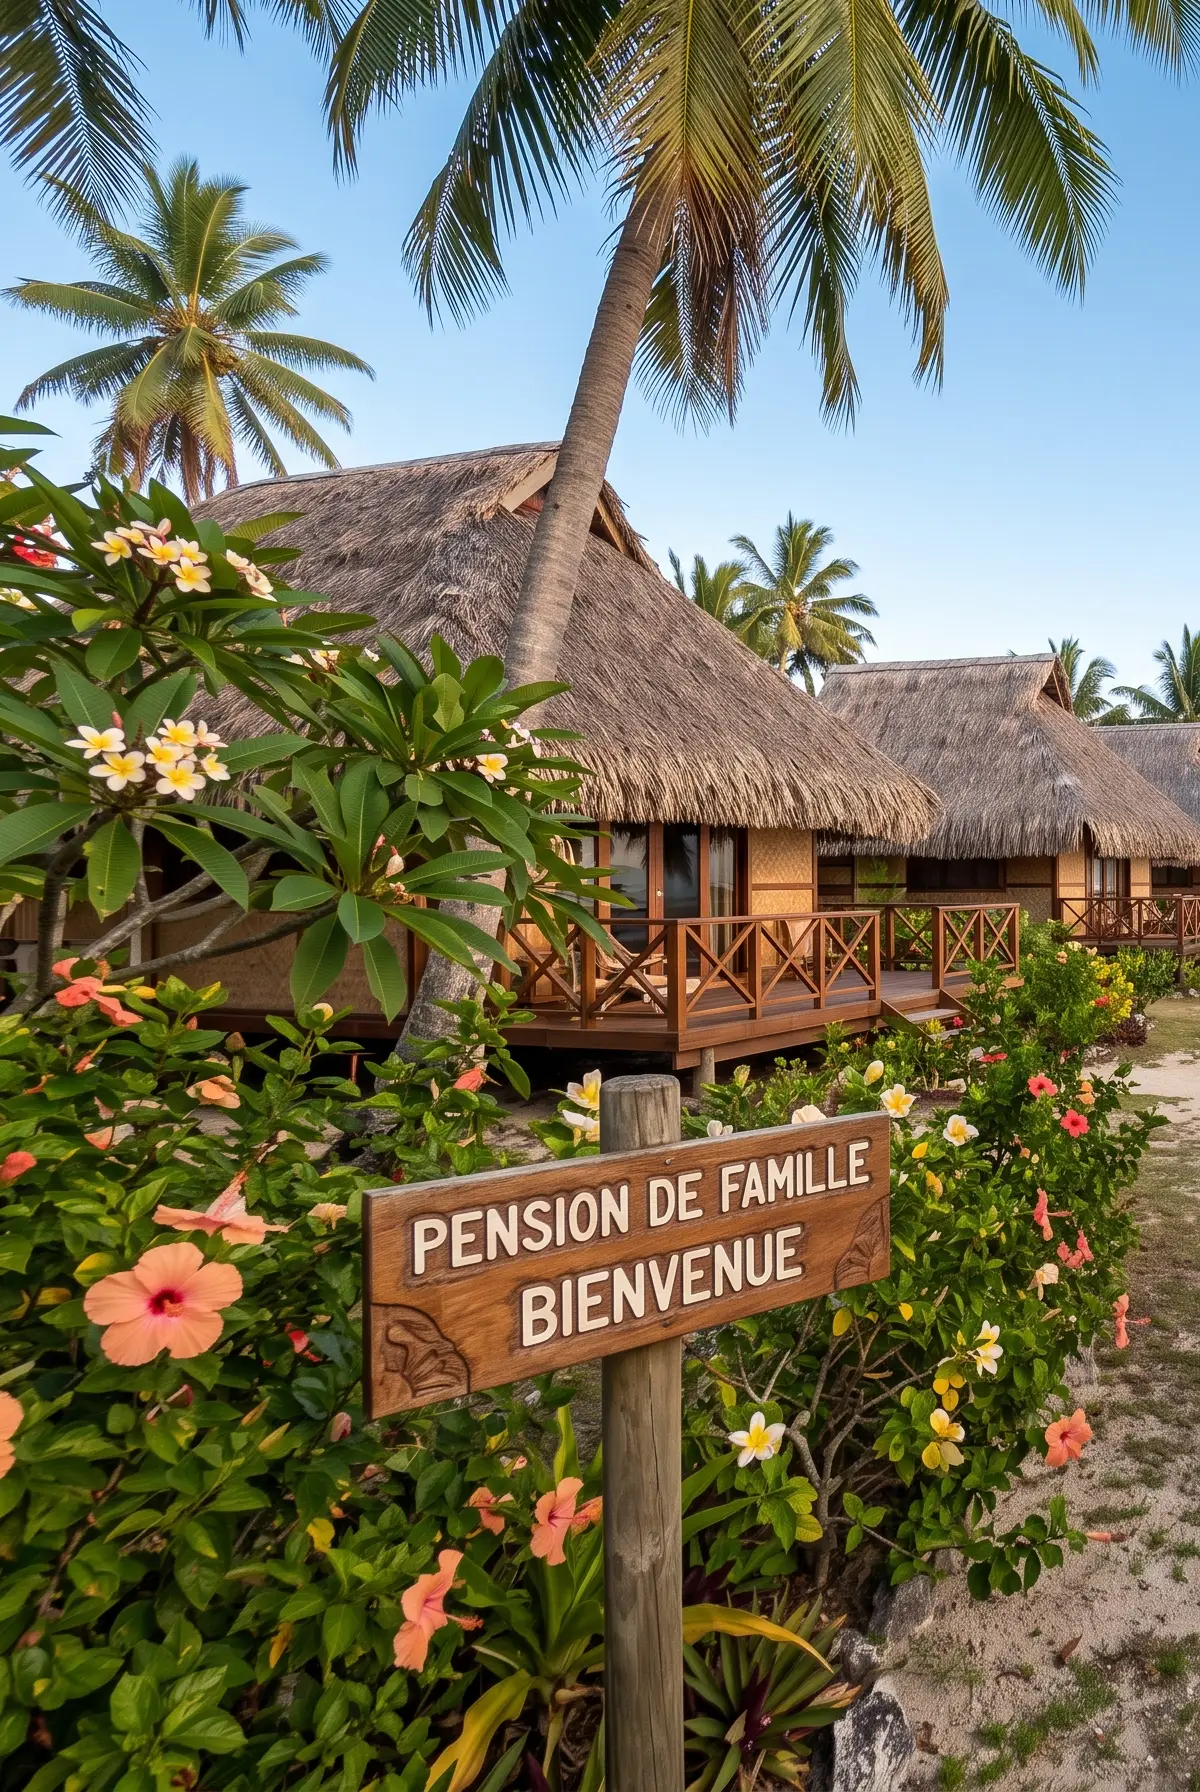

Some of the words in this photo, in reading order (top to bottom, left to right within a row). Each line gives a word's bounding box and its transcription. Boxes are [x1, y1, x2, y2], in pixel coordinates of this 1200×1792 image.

[413, 1185, 629, 1276] PENSION
[649, 1172, 703, 1228] DE
[721, 1141, 870, 1213] FAMILLE
[521, 1226, 802, 1347] BIENVENUE
